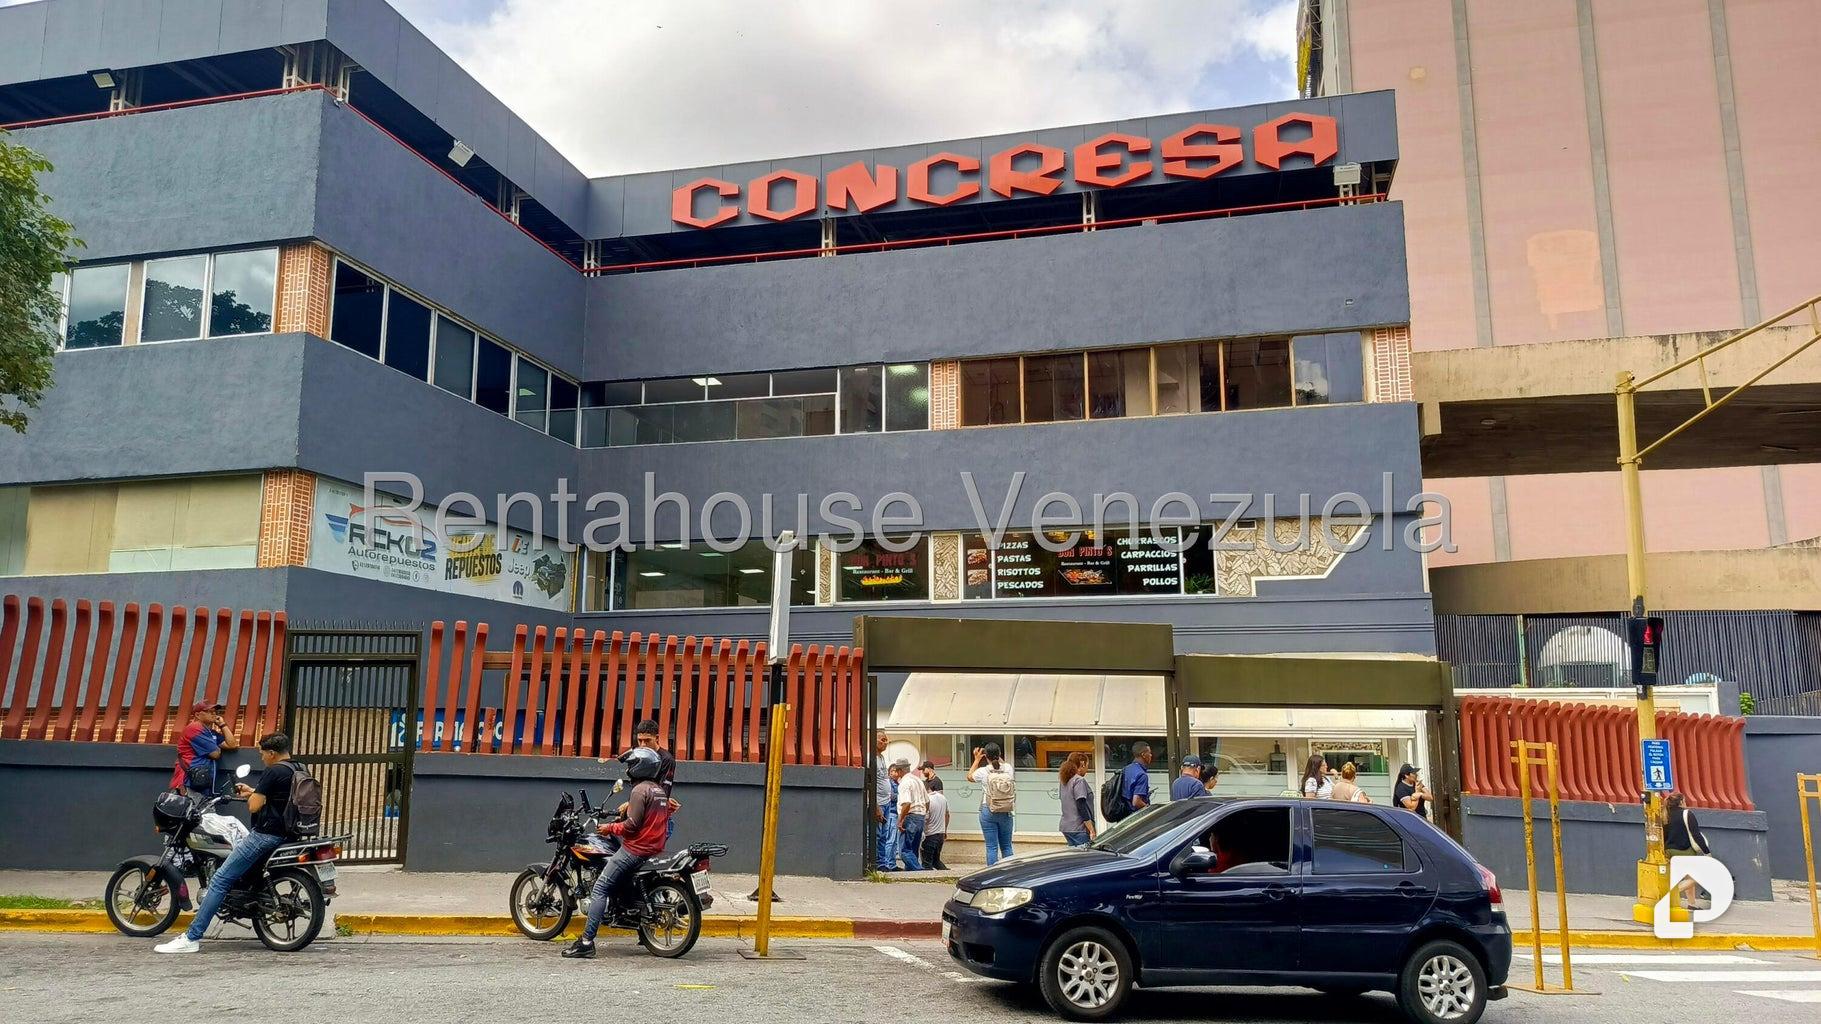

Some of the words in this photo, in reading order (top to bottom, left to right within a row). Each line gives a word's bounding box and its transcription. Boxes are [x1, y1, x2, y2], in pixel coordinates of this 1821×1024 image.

[671, 112, 1338, 229] CONCRESA
[347, 545, 436, 571] Autorepuestos
[997, 554, 1032, 563] PASTAS
[1121, 550, 1178, 559] CARPACCIOS
[445, 552, 503, 581] REPUESTOS
[1127, 563, 1178, 573] PARRILLAS
[997, 567, 1041, 576] RISOTTOS
[997, 581, 1044, 590] PESCADOS
[1142, 577, 1178, 586] POLLOS
